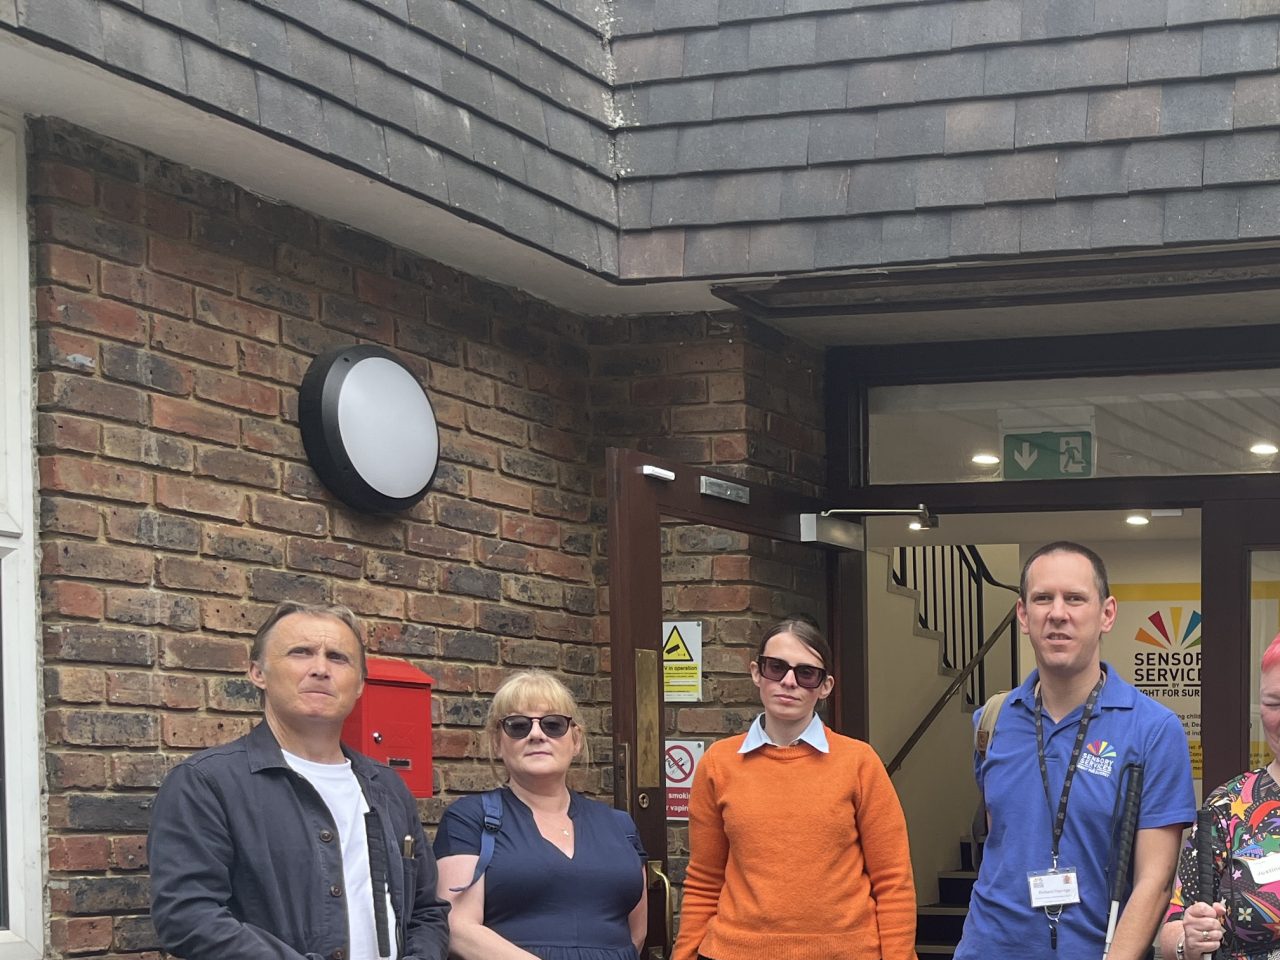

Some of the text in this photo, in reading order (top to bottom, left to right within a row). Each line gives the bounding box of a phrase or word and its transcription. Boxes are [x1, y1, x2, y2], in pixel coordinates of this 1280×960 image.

[1134, 652, 1201, 666] SENSOR
[1134, 668, 1201, 682] SERVIC
[1162, 689, 1179, 697] FOR
[1181, 689, 1200, 697] SUR
[1080, 758, 1112, 771] SERVICES
[1082, 753, 1114, 766] SENSORY
[670, 805, 689, 813] vapin
